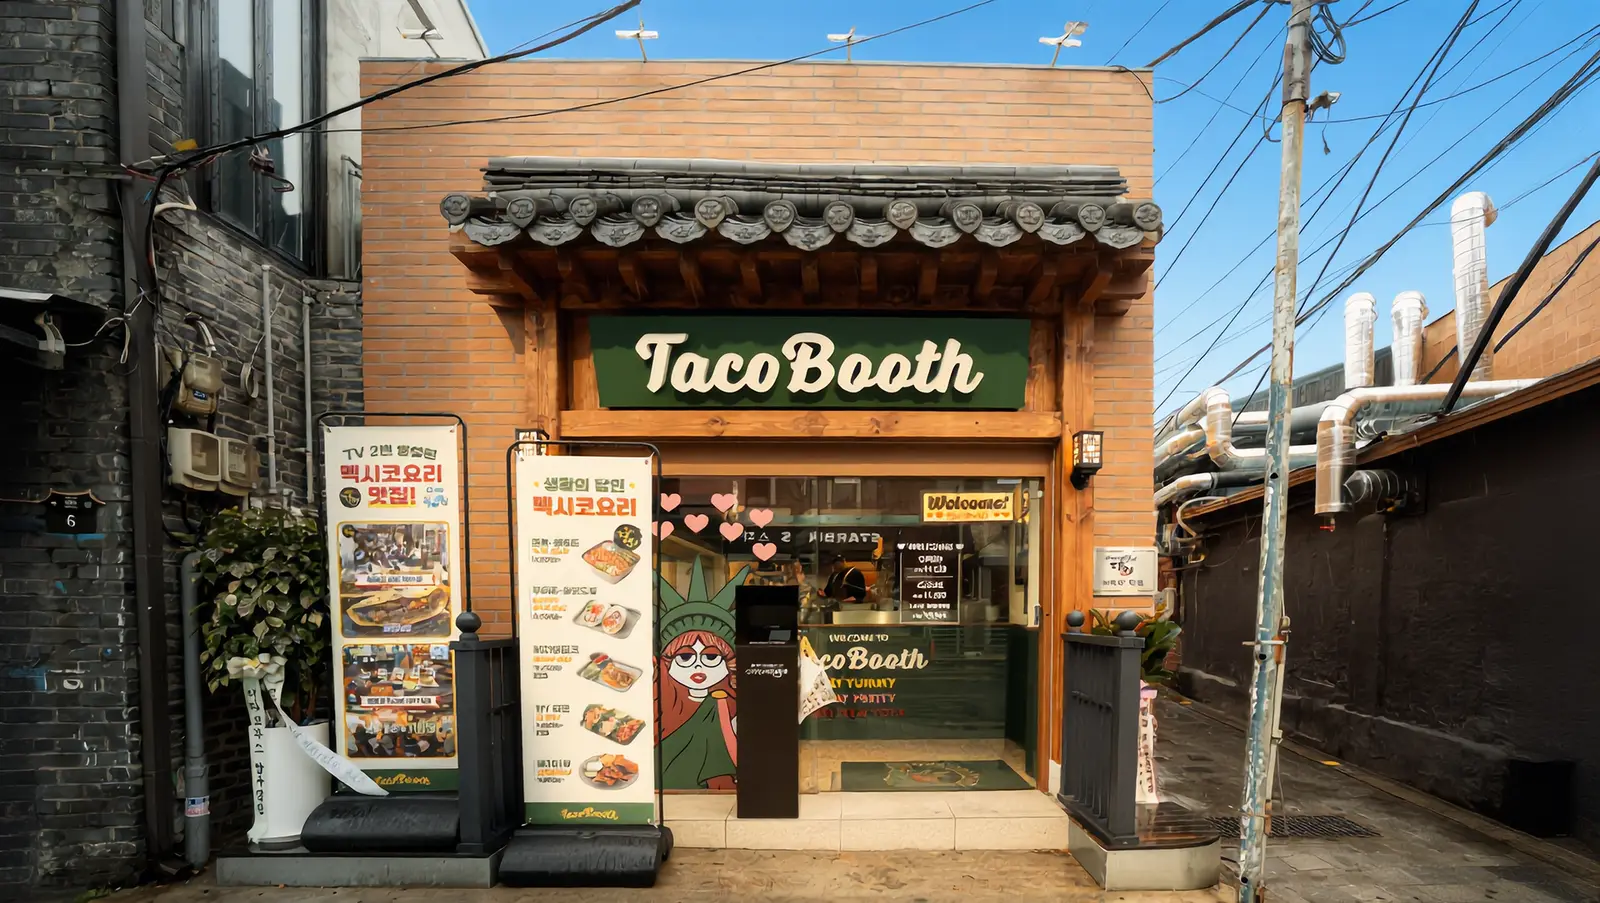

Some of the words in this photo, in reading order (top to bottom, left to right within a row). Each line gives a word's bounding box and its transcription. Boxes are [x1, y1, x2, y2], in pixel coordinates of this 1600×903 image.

[634, 331, 779, 394] Taco
[781, 331, 984, 394] Booth
[342, 446, 364, 460] TV
[368, 486, 417, 505] 맛집!
[67, 514, 76, 527] 6
